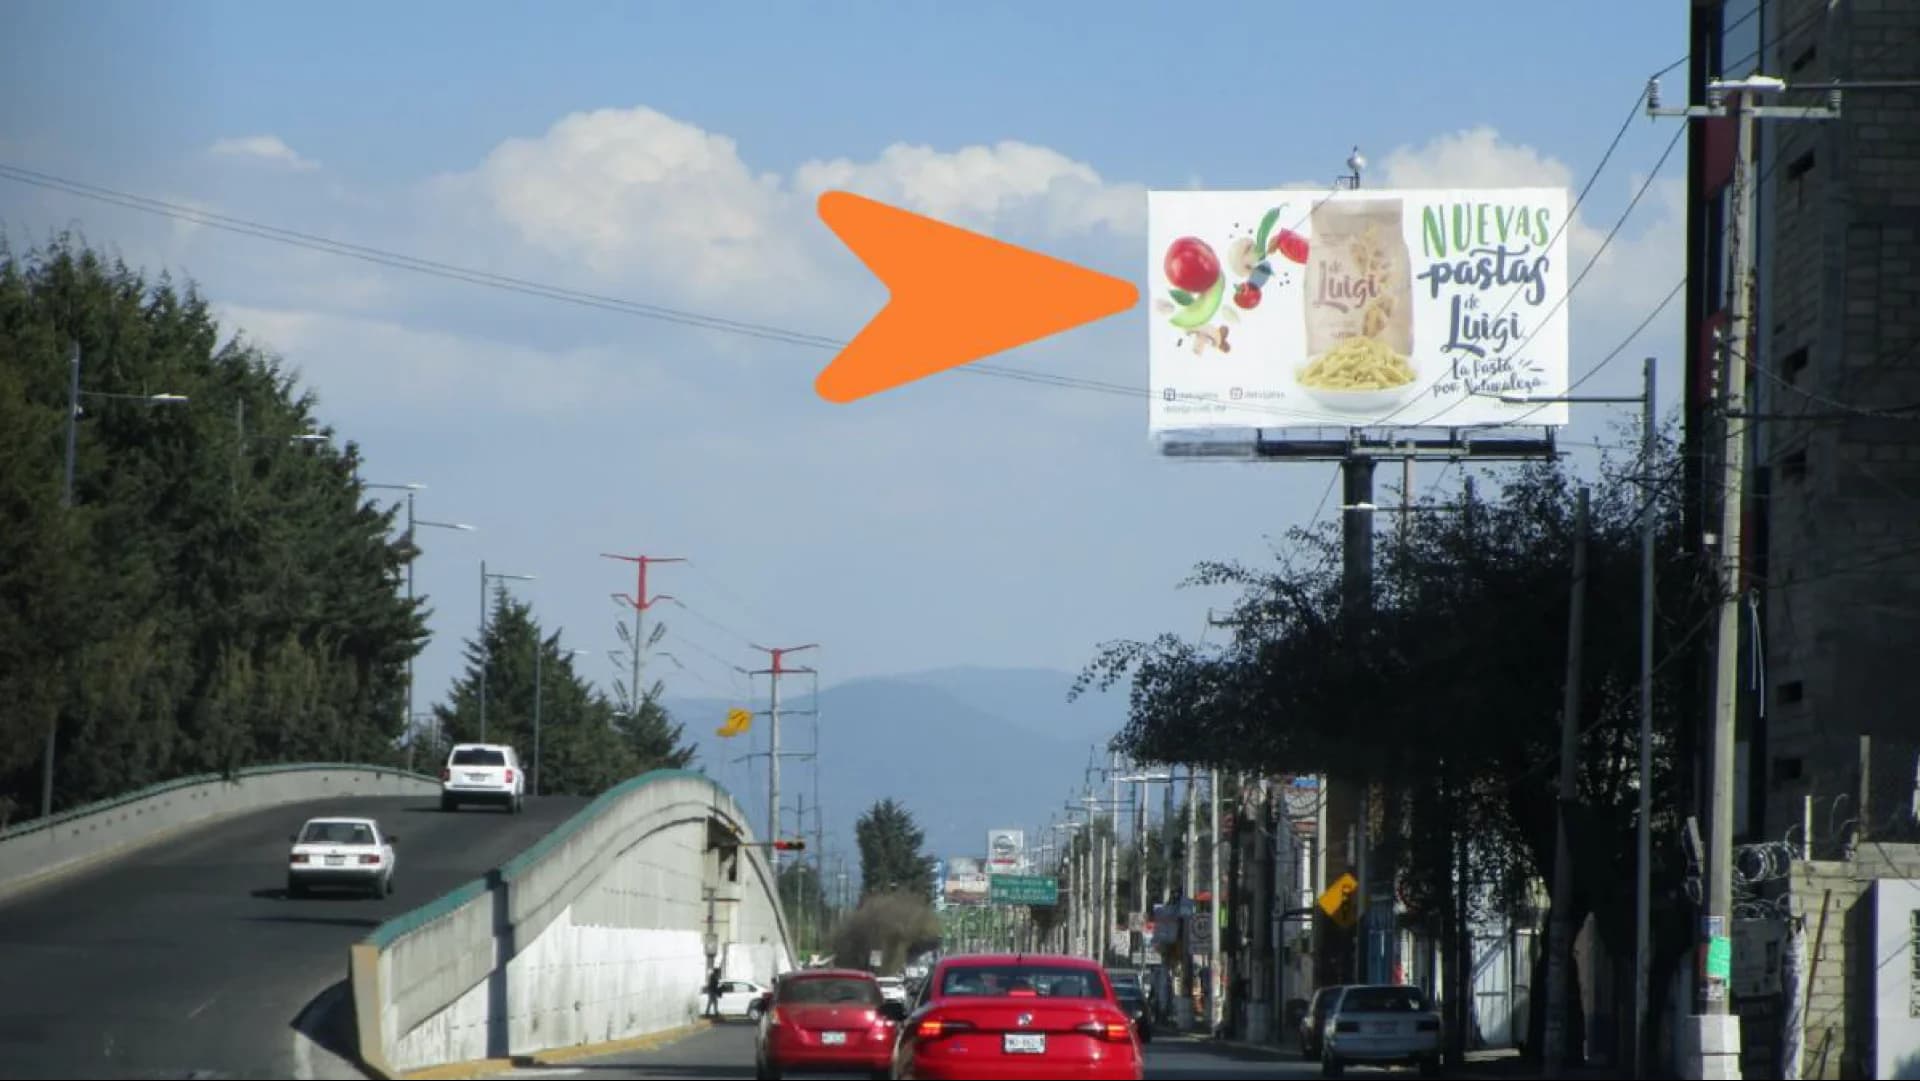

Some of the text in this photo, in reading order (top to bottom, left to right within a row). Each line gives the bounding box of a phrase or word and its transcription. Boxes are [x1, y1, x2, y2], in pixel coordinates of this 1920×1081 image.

[1422, 203, 1550, 258] NUEVAS
[1312, 260, 1377, 313] Luigi
[1417, 244, 1550, 305] pastas
[1441, 295, 1521, 357] Luigi
[1464, 294, 1479, 309] de
[1432, 383, 1458, 398] por
[1452, 357, 1469, 380] La
